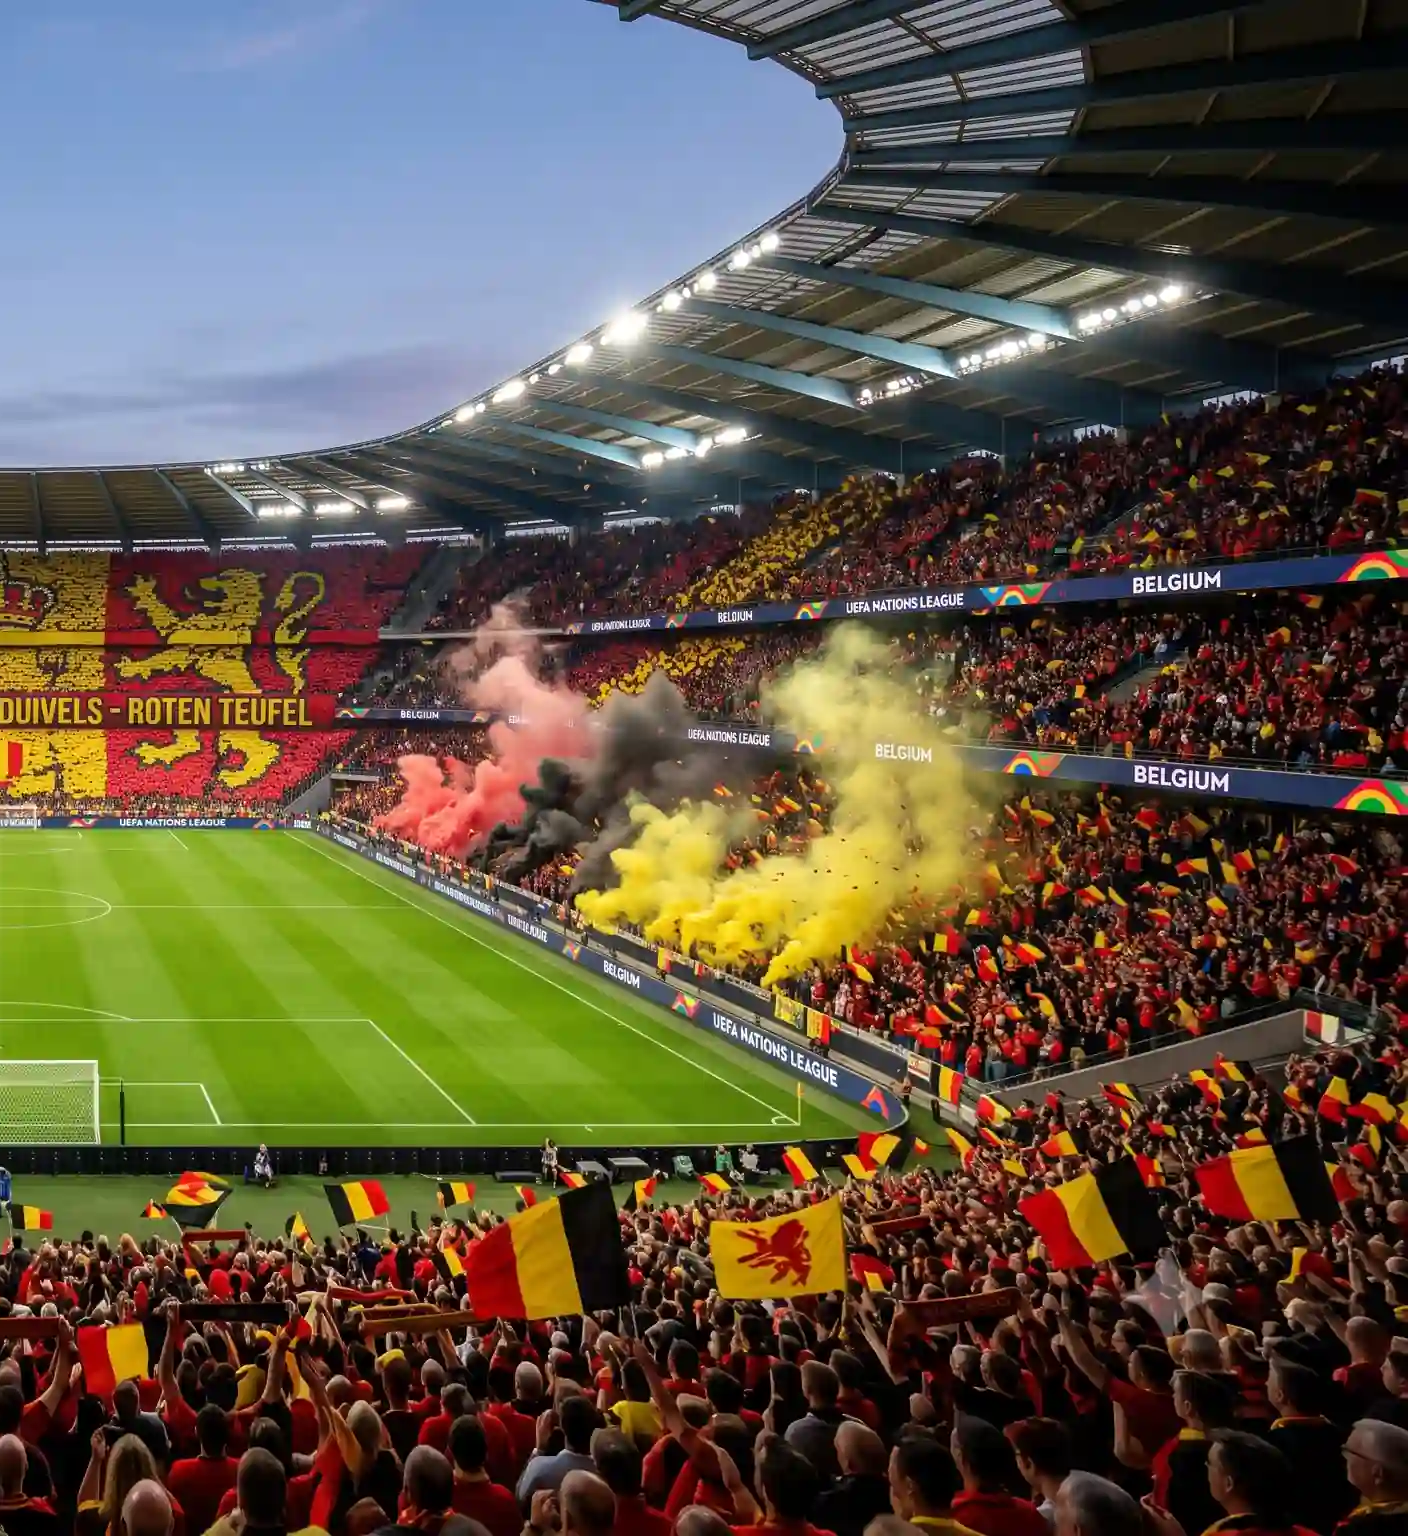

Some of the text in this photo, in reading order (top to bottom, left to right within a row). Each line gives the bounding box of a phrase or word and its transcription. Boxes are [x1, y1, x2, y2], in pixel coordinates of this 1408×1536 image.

[1133, 570, 1221, 594] BELGIUM
[846, 592, 964, 614] UEFA NATIONS LEAGUE
[128, 697, 211, 725] ROTEN
[218, 697, 313, 726] TEUFEL
[738, 732, 770, 747] LEAGUE
[875, 743, 932, 763] BELGIUM
[1134, 765, 1229, 792] BELGIUM
[119, 819, 142, 827] UEFA
[189, 818, 226, 827] LEAGUE
[604, 960, 640, 988] BELGIUM
[712, 1011, 838, 1088] UEFA NATIONS LEAGUE
